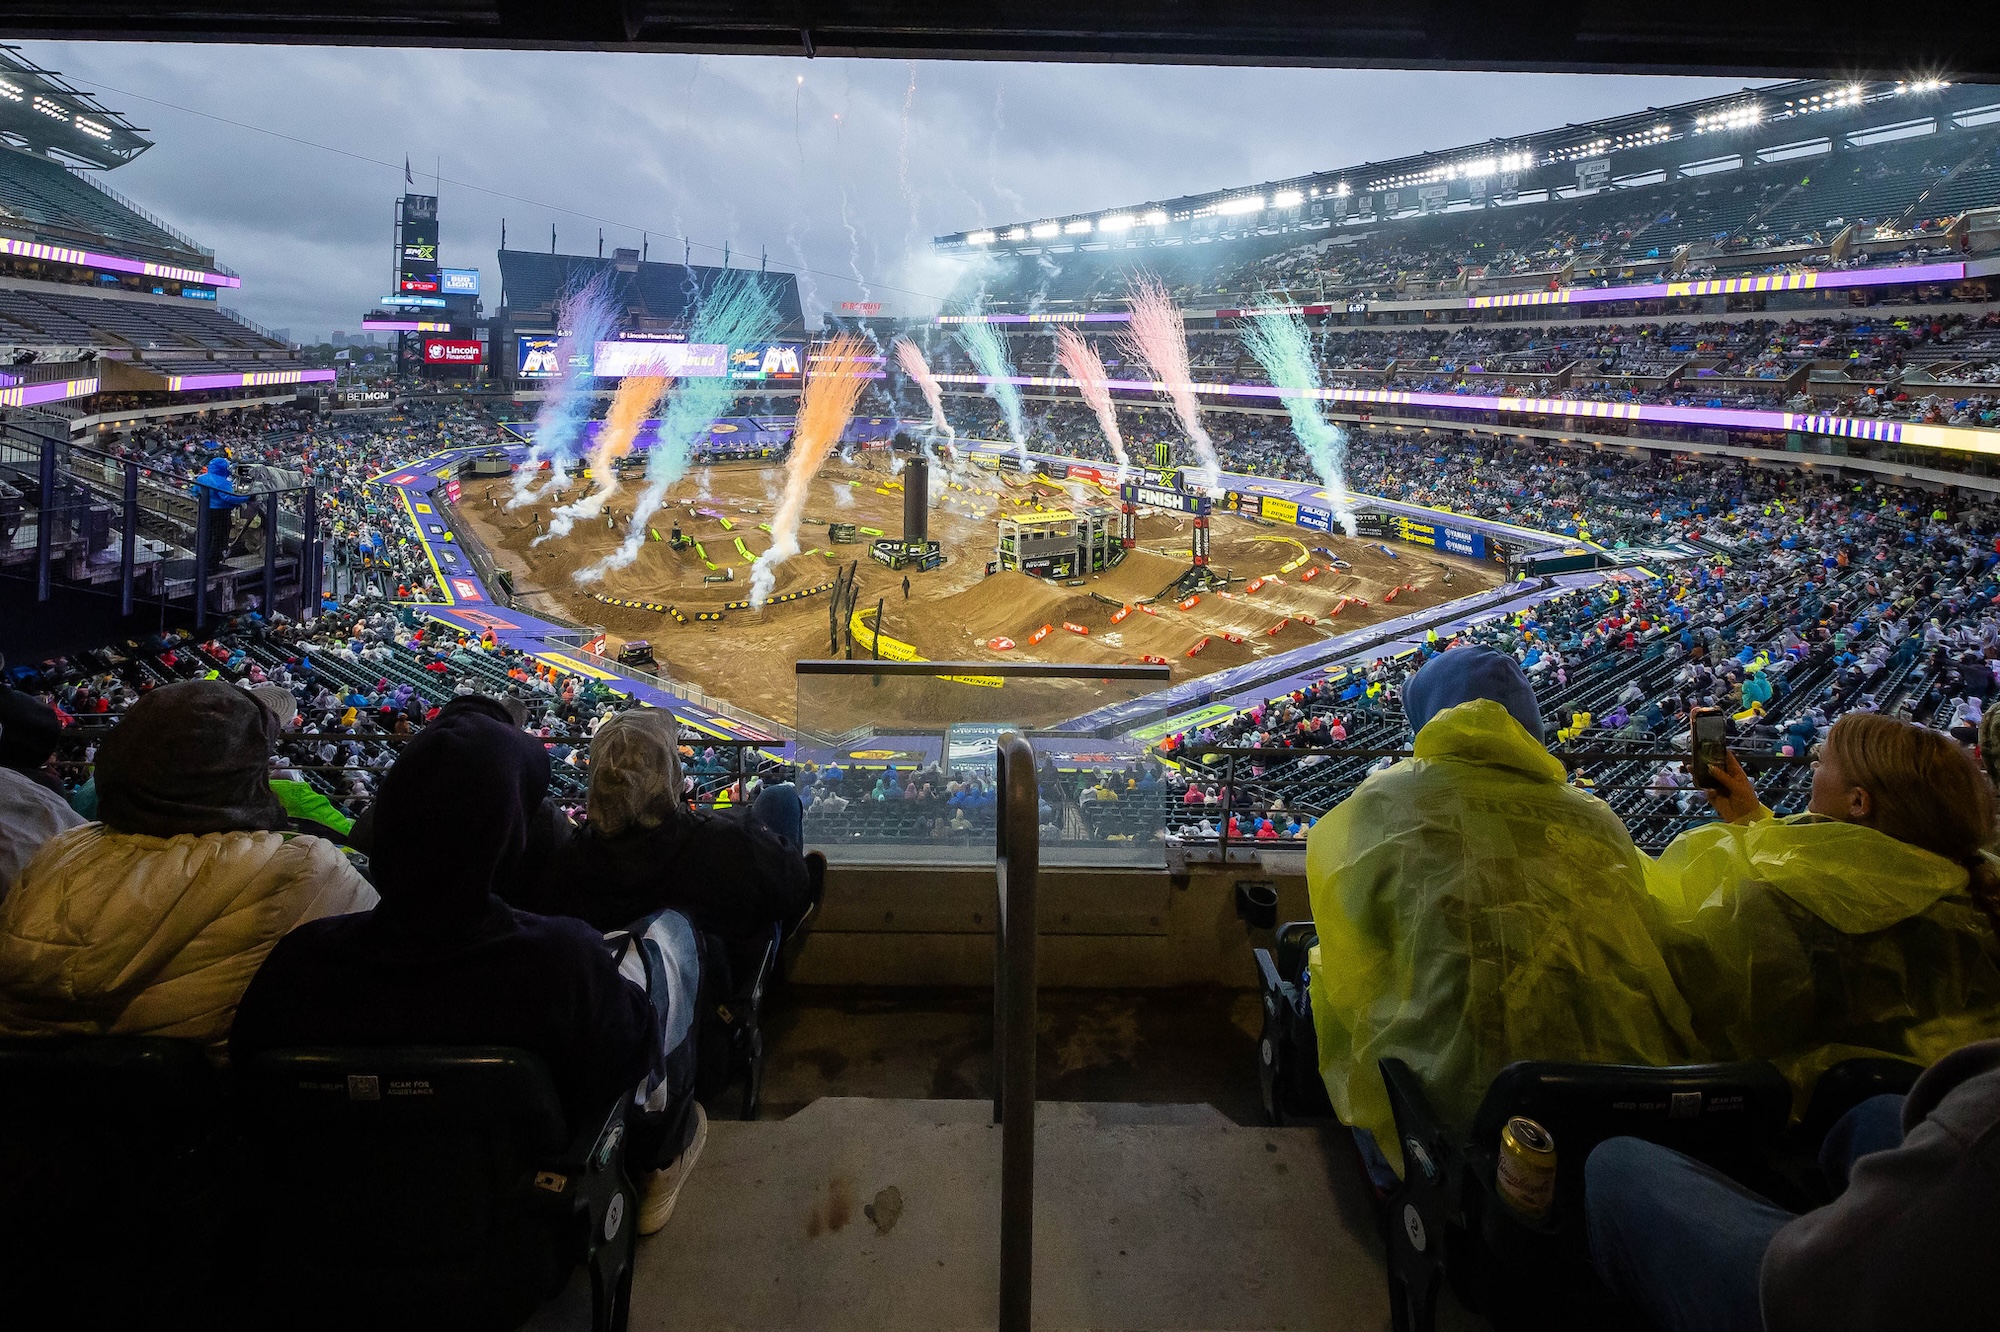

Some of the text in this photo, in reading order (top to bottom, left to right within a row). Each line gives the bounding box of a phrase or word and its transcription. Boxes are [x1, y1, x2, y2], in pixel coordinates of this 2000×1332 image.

[405, 247, 434, 259] SMX
[447, 280, 474, 288] LIGHT
[446, 346, 479, 355] Lincoln
[346, 391, 389, 401] BETMGM
[1075, 468, 1098, 477] HONDA
[1145, 471, 1175, 488] SMX
[1137, 488, 1184, 510] FINISH
[1271, 500, 1296, 510] DUNLOP
[1028, 513, 1071, 521] DUNLOP
[1270, 510, 1295, 520] DUNLOP
[1450, 529, 1473, 541] YAMAHA
[1450, 541, 1474, 553] YAMAHA
[1115, 609, 1127, 620] FLY
[1069, 624, 1083, 632] FLY
[1034, 628, 1047, 641] FLY
[884, 642, 912, 655] DUNLOP
[963, 677, 1001, 687] DUNLOP
[413, 1080, 430, 1088] FOR
